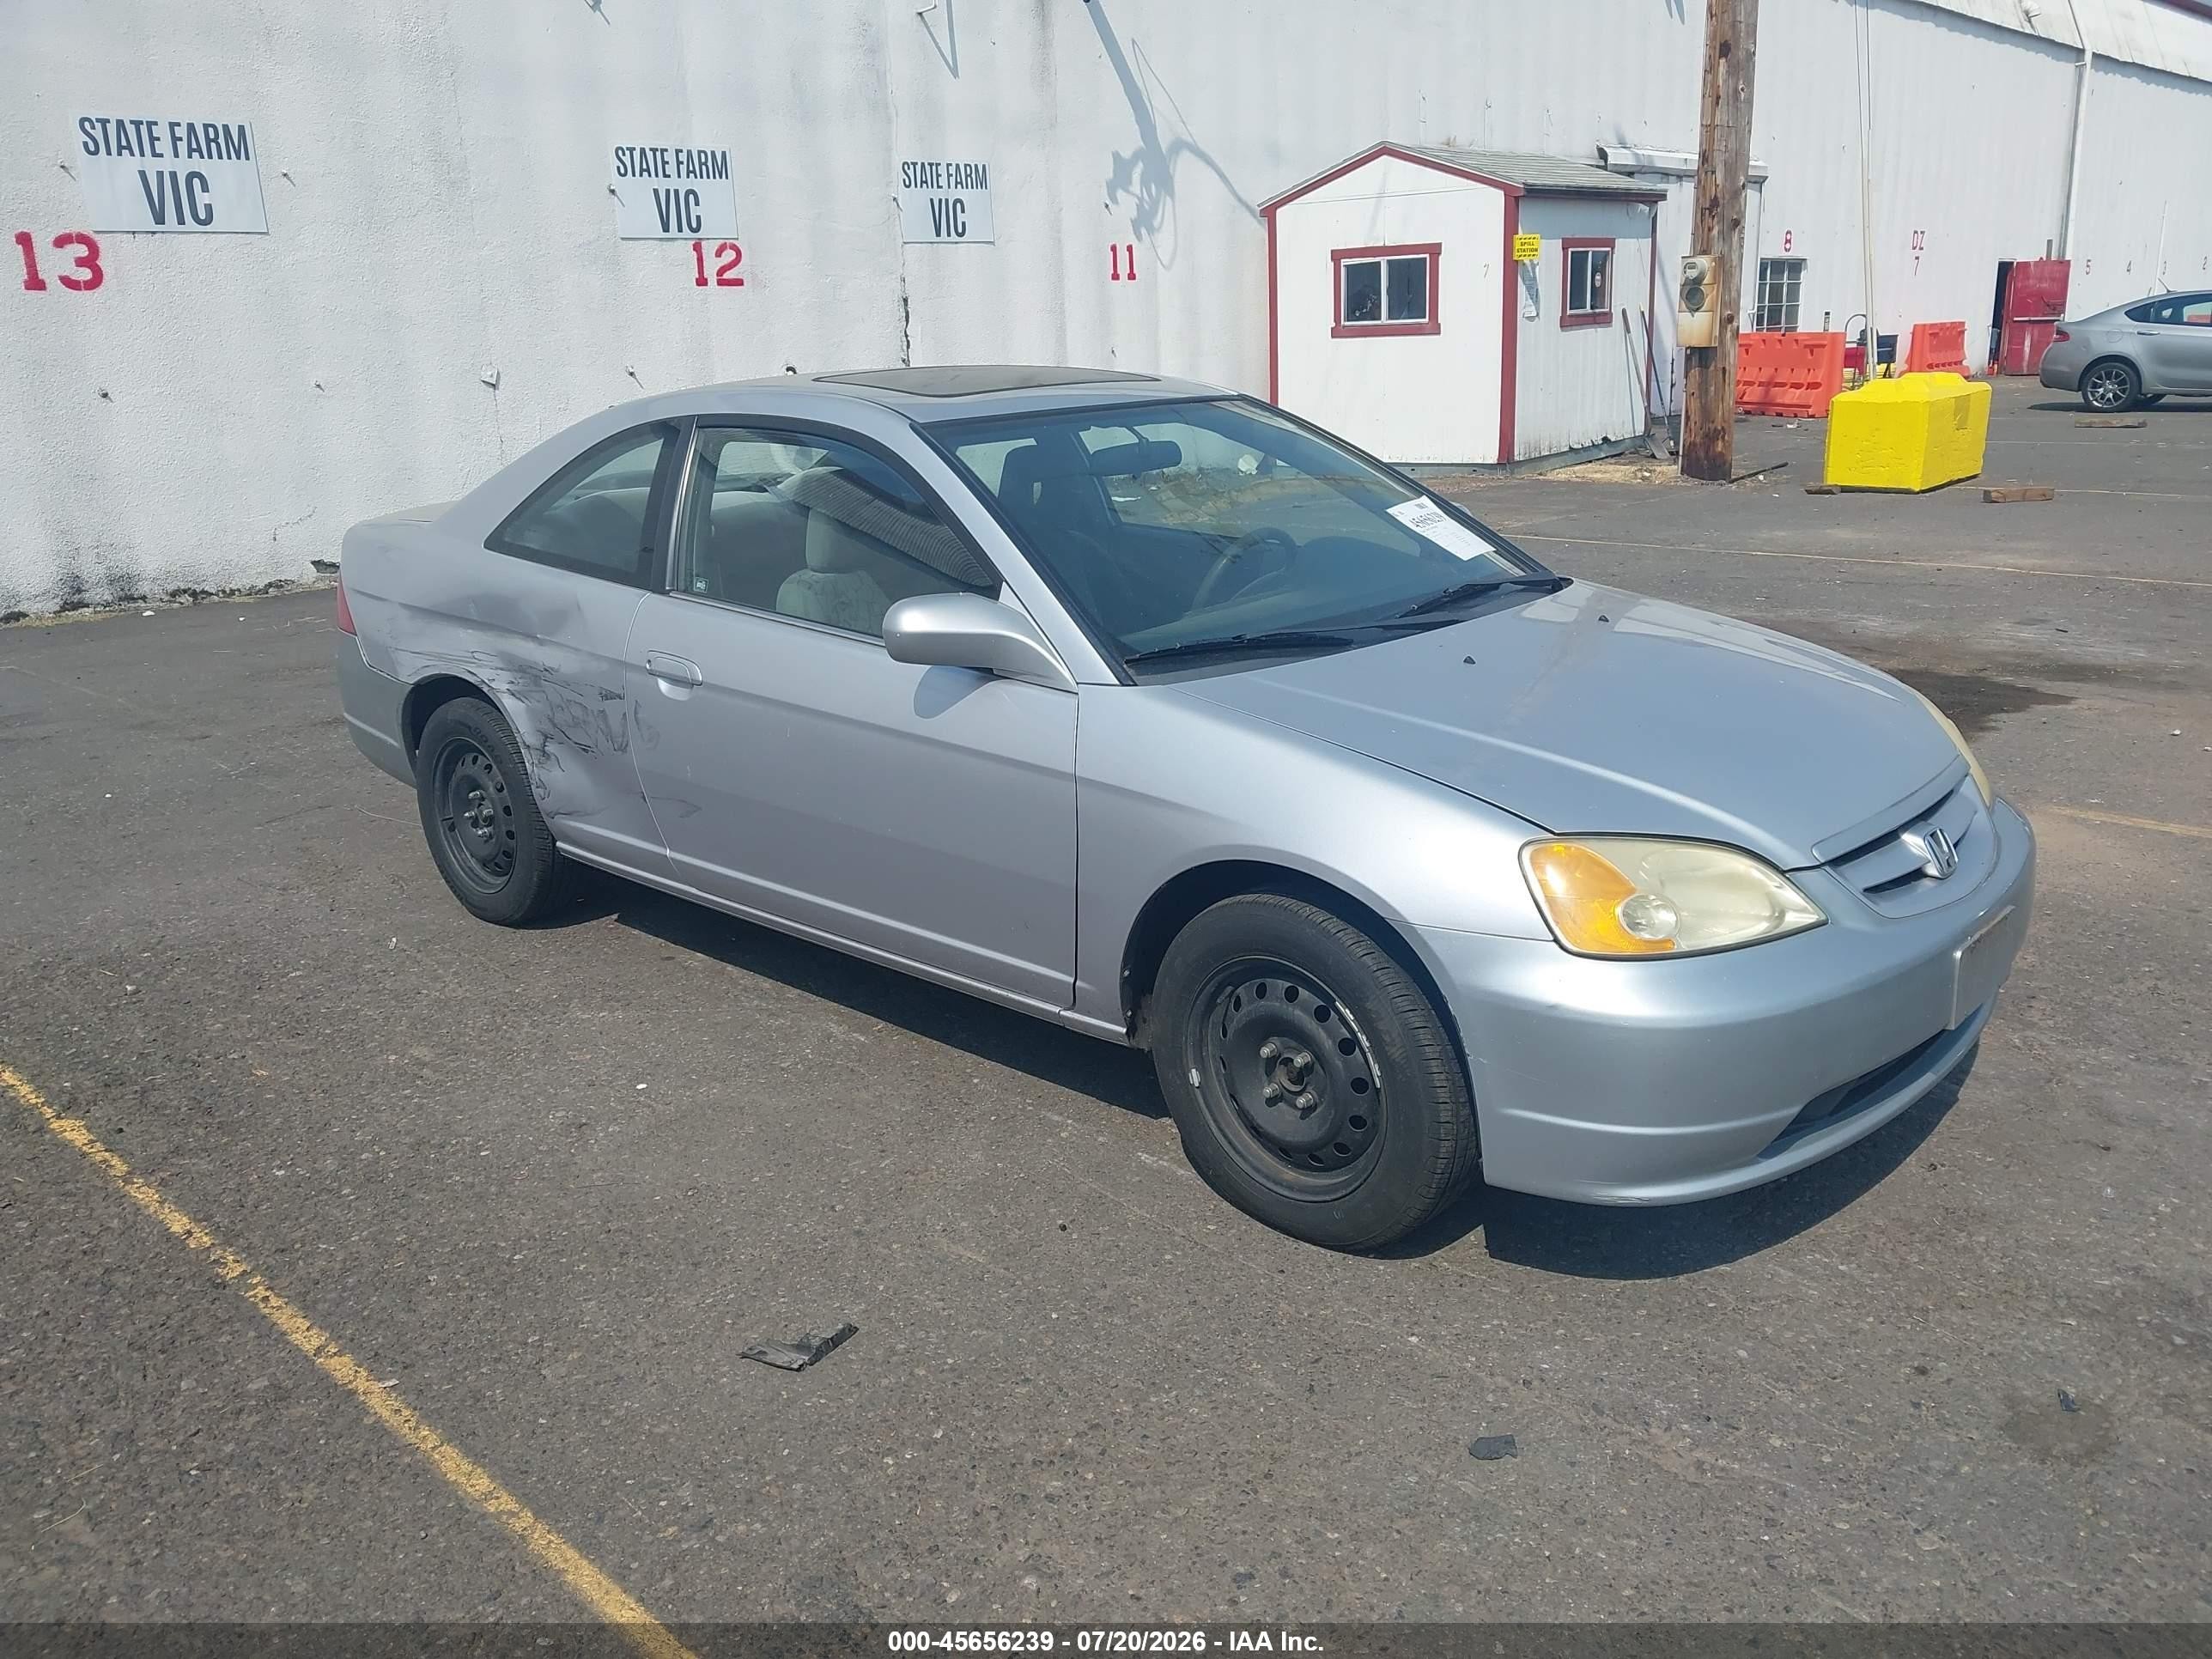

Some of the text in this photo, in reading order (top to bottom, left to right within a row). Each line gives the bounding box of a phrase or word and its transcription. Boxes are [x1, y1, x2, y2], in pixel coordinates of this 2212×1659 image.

[79, 117, 250, 161] STATE FARM
[614, 146, 729, 180] STATE FARM
[902, 161, 988, 191] STATE FARM
[137, 170, 214, 227] VIC
[653, 187, 702, 234] VIC
[930, 198, 967, 238] VIC
[1784, 229, 1793, 252] 8
[1911, 229, 1926, 251] DZ
[15, 231, 104, 292] 13
[692, 242, 744, 287] 12
[1110, 244, 1137, 281] 11
[1914, 255, 1920, 276] 7
[2085, 258, 2092, 276] 5
[2126, 260, 2132, 276] 4
[2202, 256, 2208, 270] 2
